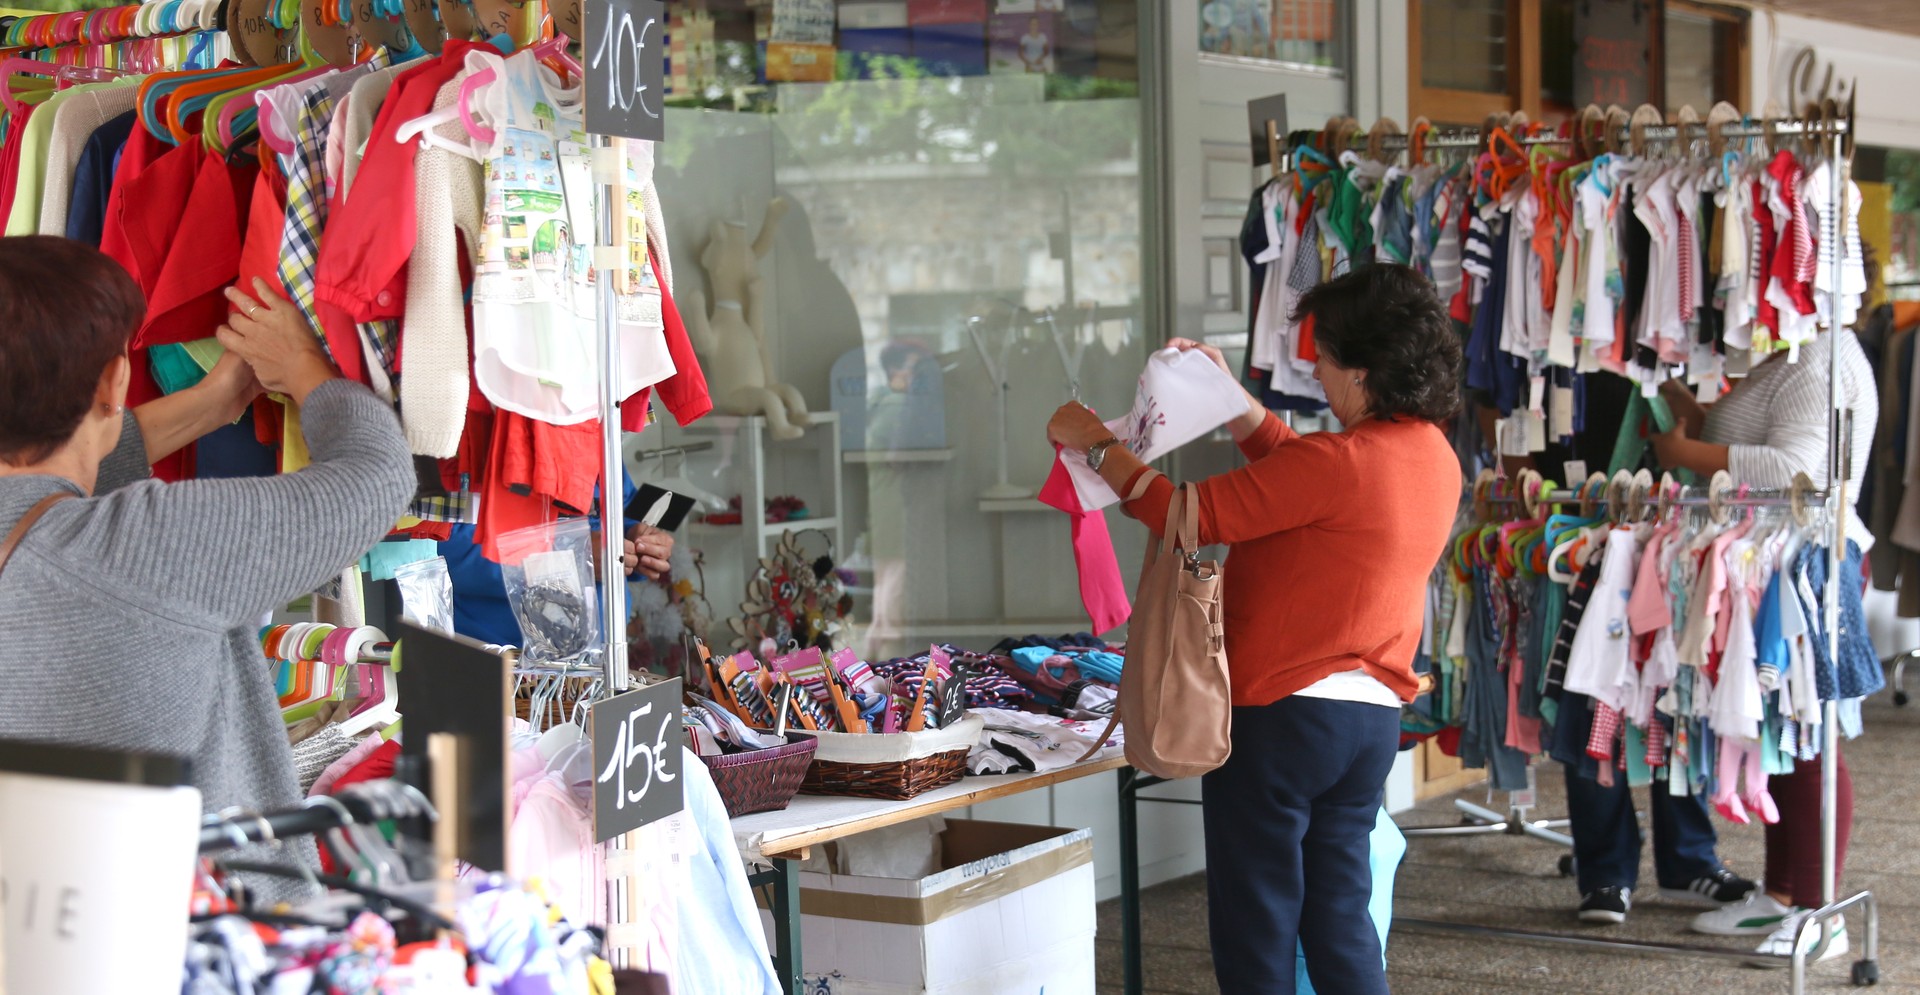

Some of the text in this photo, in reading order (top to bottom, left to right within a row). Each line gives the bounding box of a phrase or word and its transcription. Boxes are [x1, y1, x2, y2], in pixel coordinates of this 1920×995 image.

[244, 15, 266, 36] 10A
[592, 4, 659, 118] 10€
[943, 682, 961, 719] 2€
[597, 701, 676, 810] 15€
